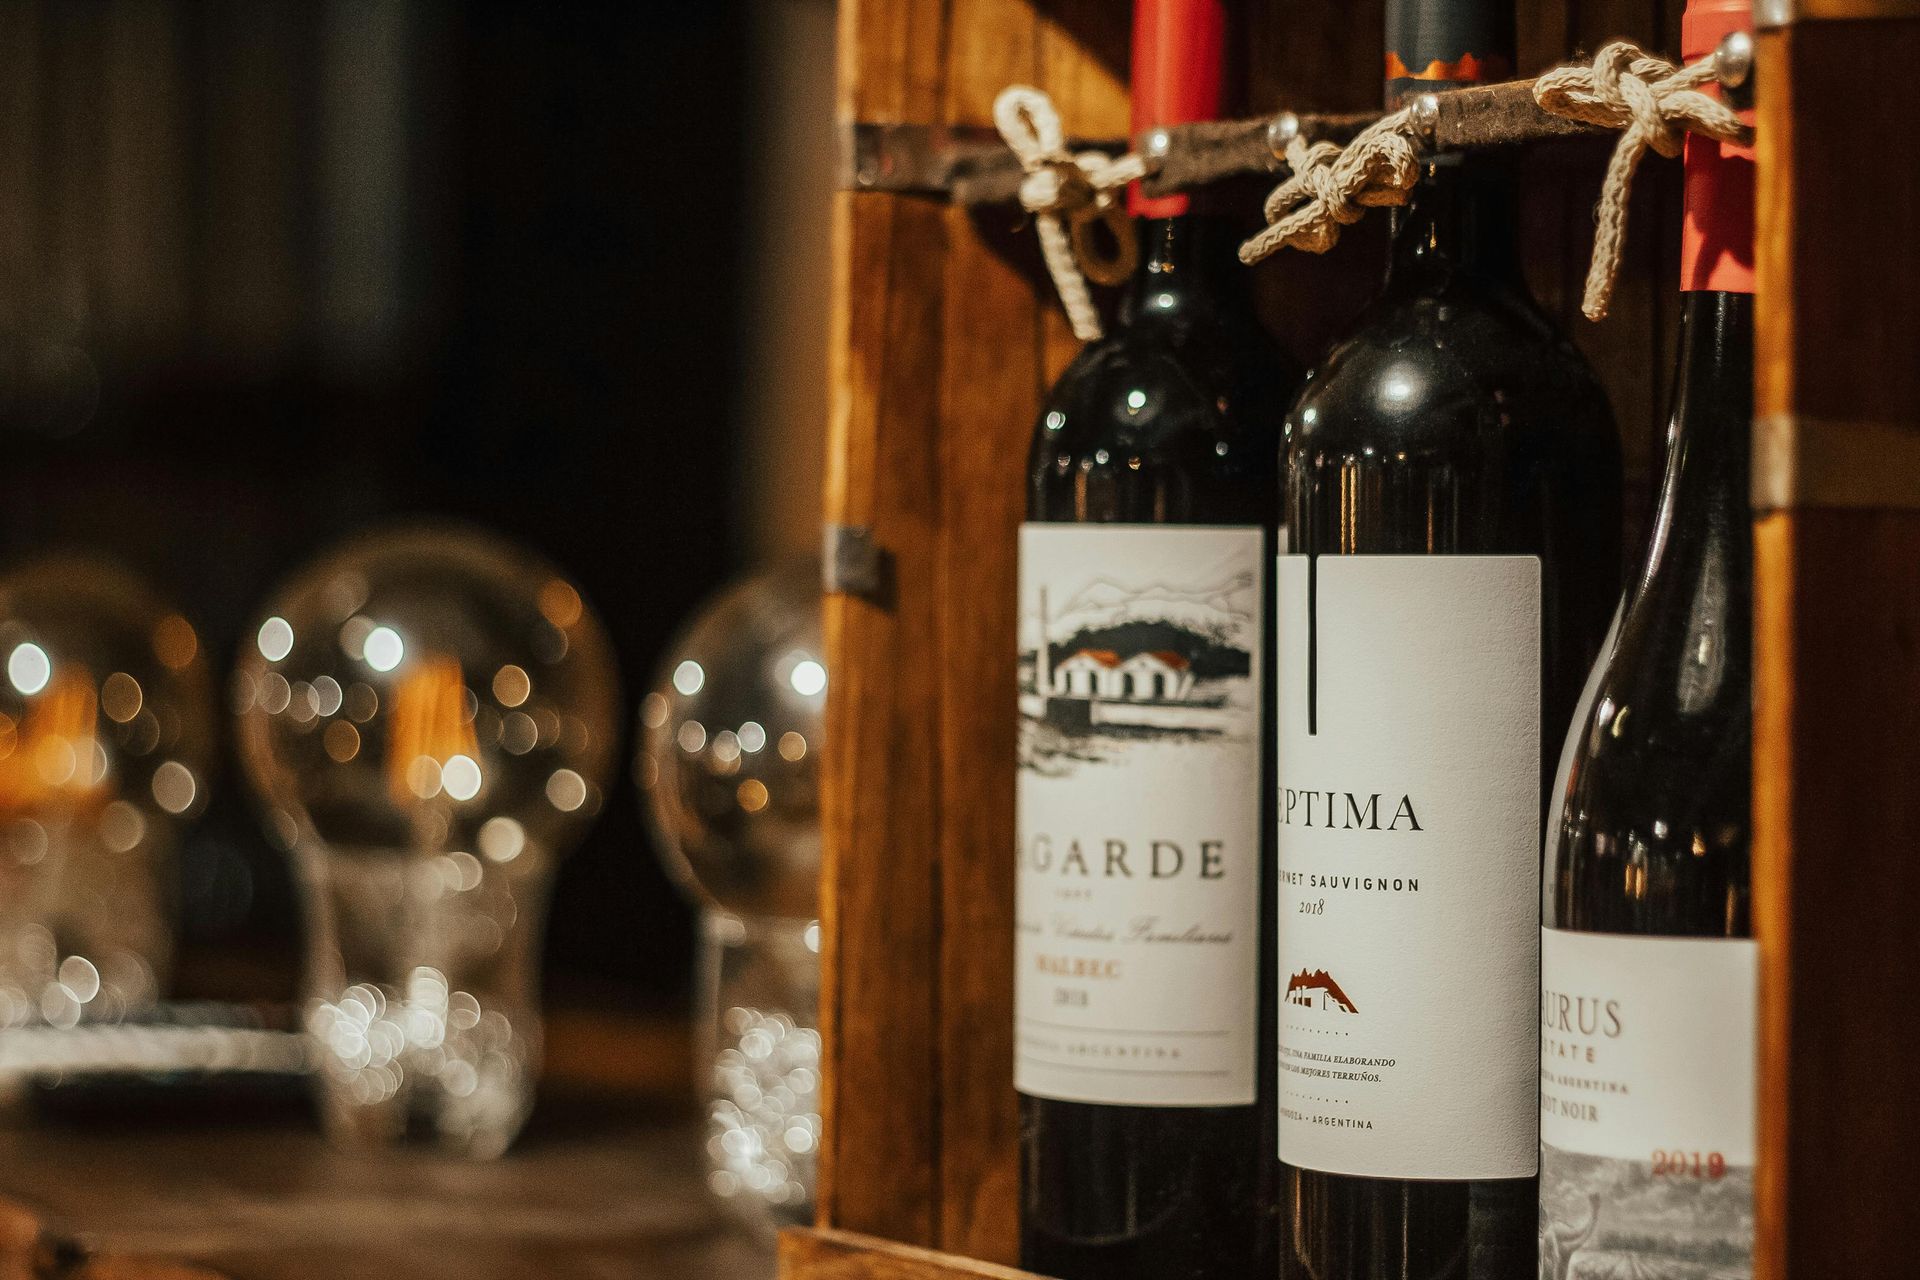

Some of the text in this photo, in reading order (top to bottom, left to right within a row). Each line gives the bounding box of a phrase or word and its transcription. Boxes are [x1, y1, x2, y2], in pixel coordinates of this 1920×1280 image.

[1310, 874, 1419, 892] SAUVIGNON
[1299, 898, 1325, 916] 2018
[1304, 1051, 1331, 1063] FAMILIA
[1333, 1055, 1396, 1068] ELABORANDO
[1300, 1066, 1330, 1078] MEJORES
[1332, 1071, 1382, 1083] TERRUÑOS.
[1560, 1100, 1599, 1122] NOIR
[1312, 1115, 1373, 1130] ARGENTINA
